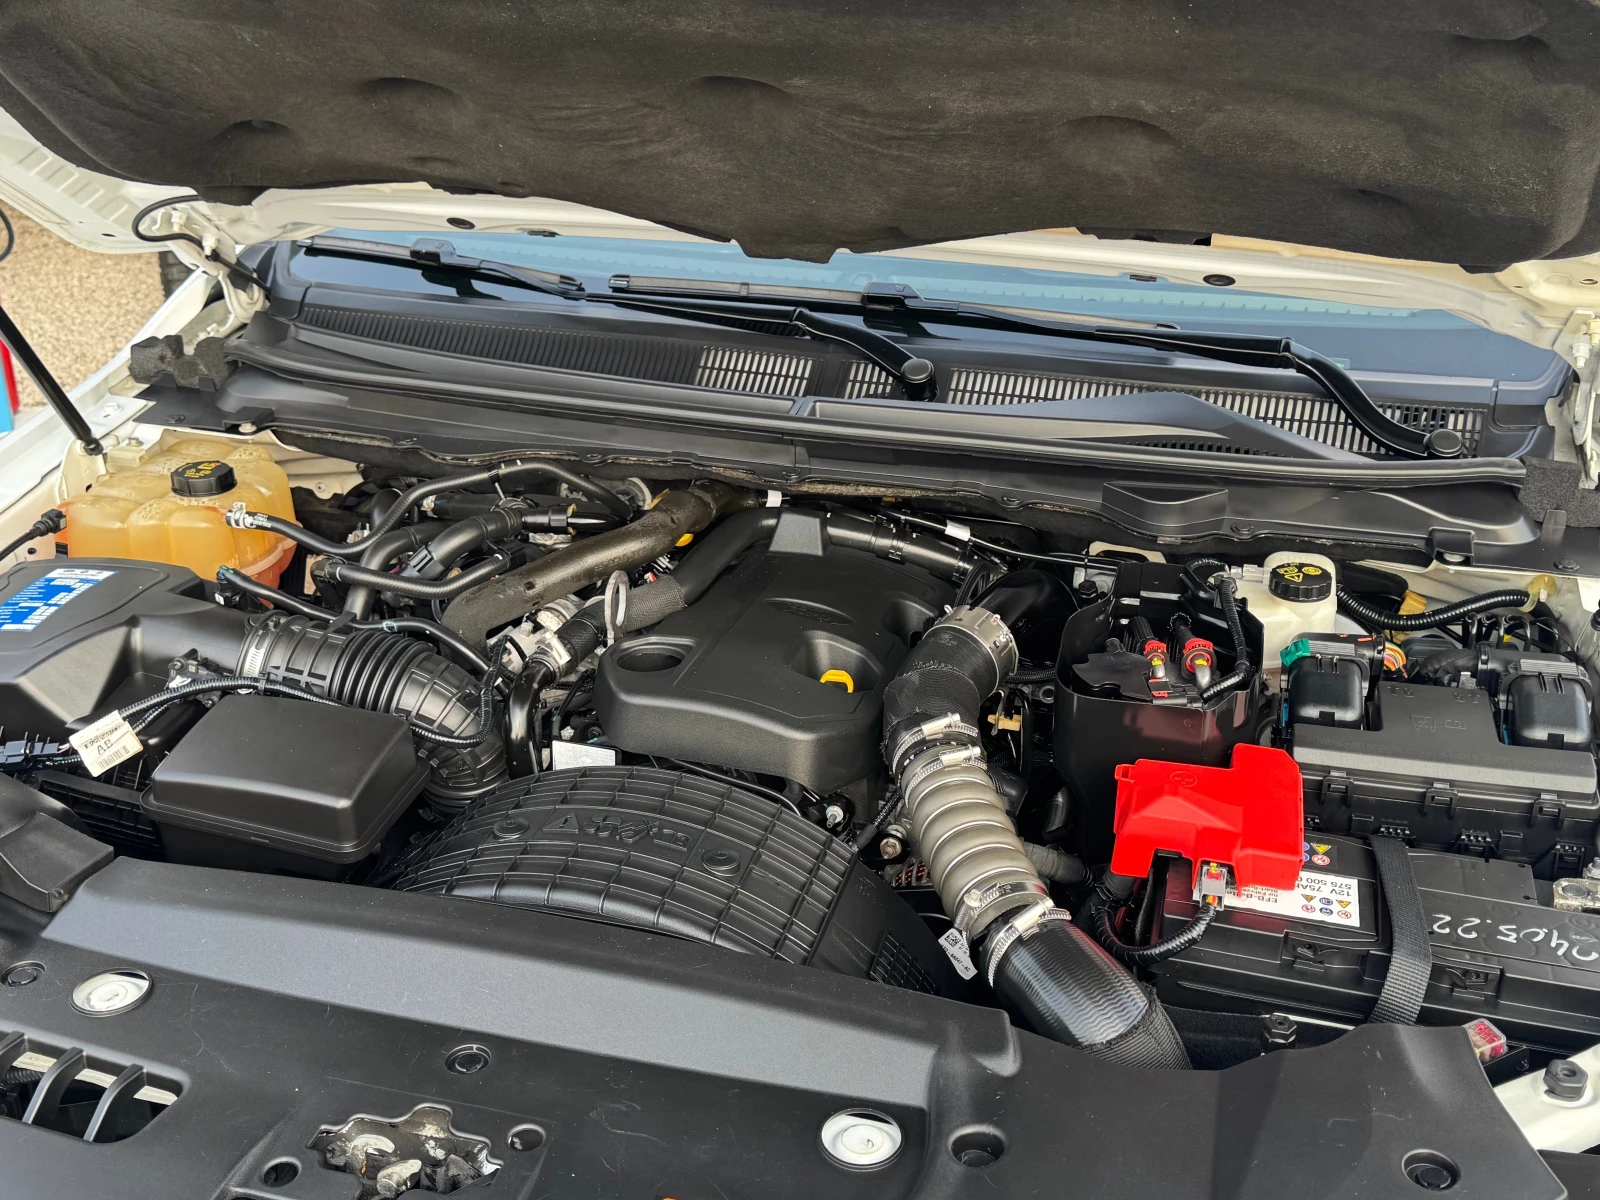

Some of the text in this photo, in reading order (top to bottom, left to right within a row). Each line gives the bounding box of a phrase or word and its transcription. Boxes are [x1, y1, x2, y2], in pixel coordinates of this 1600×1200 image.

[97, 740, 113, 755] AB
[1306, 877, 1327, 886] 500
[1330, 881, 1352, 890] 575
[1330, 888, 1351, 897] 12V
